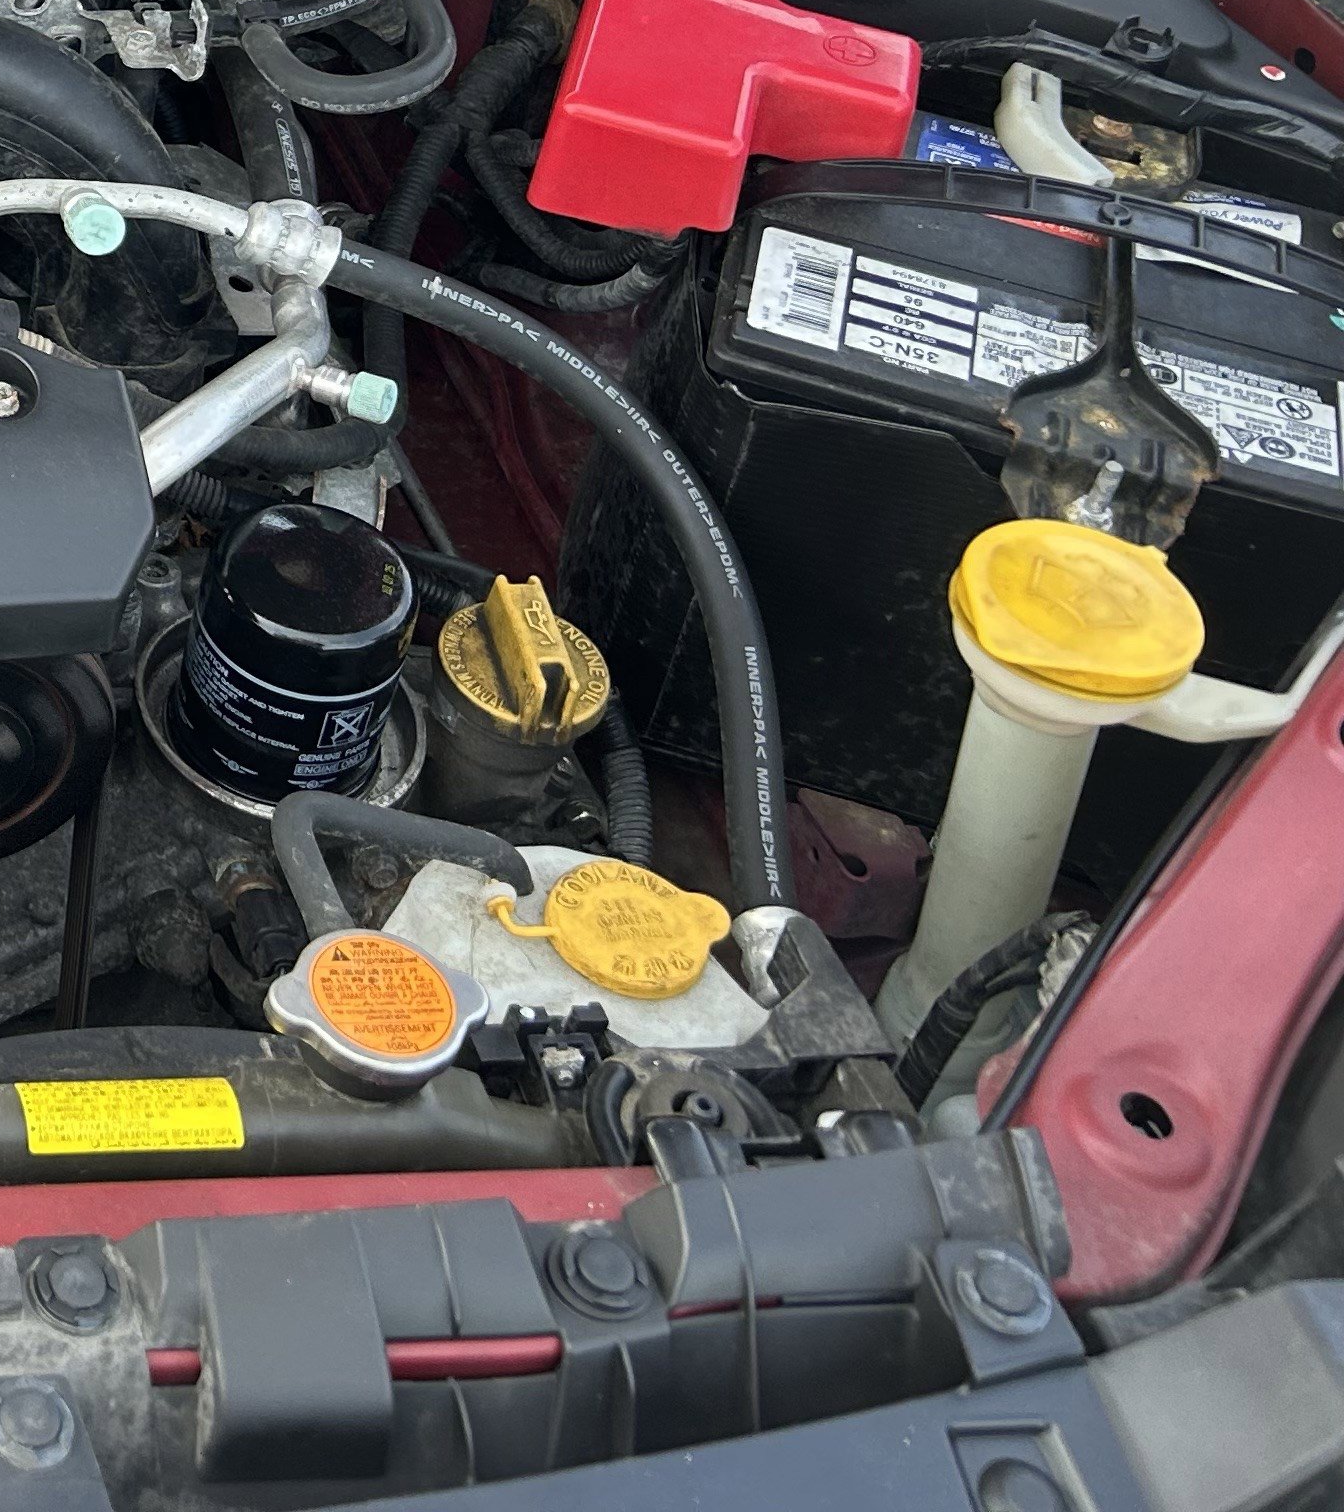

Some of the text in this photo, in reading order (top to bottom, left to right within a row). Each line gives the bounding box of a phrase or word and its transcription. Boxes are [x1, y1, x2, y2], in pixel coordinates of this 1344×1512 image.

[1233, 211, 1283, 232] Power
[893, 314, 926, 330] 640
[869, 335, 940, 364] 35N-C
[579, 680, 605, 705] OIL
[555, 864, 679, 909] COOLANT
[350, 949, 404, 957] WARNING
[354, 1023, 437, 1034] AVERTISSEMENT
